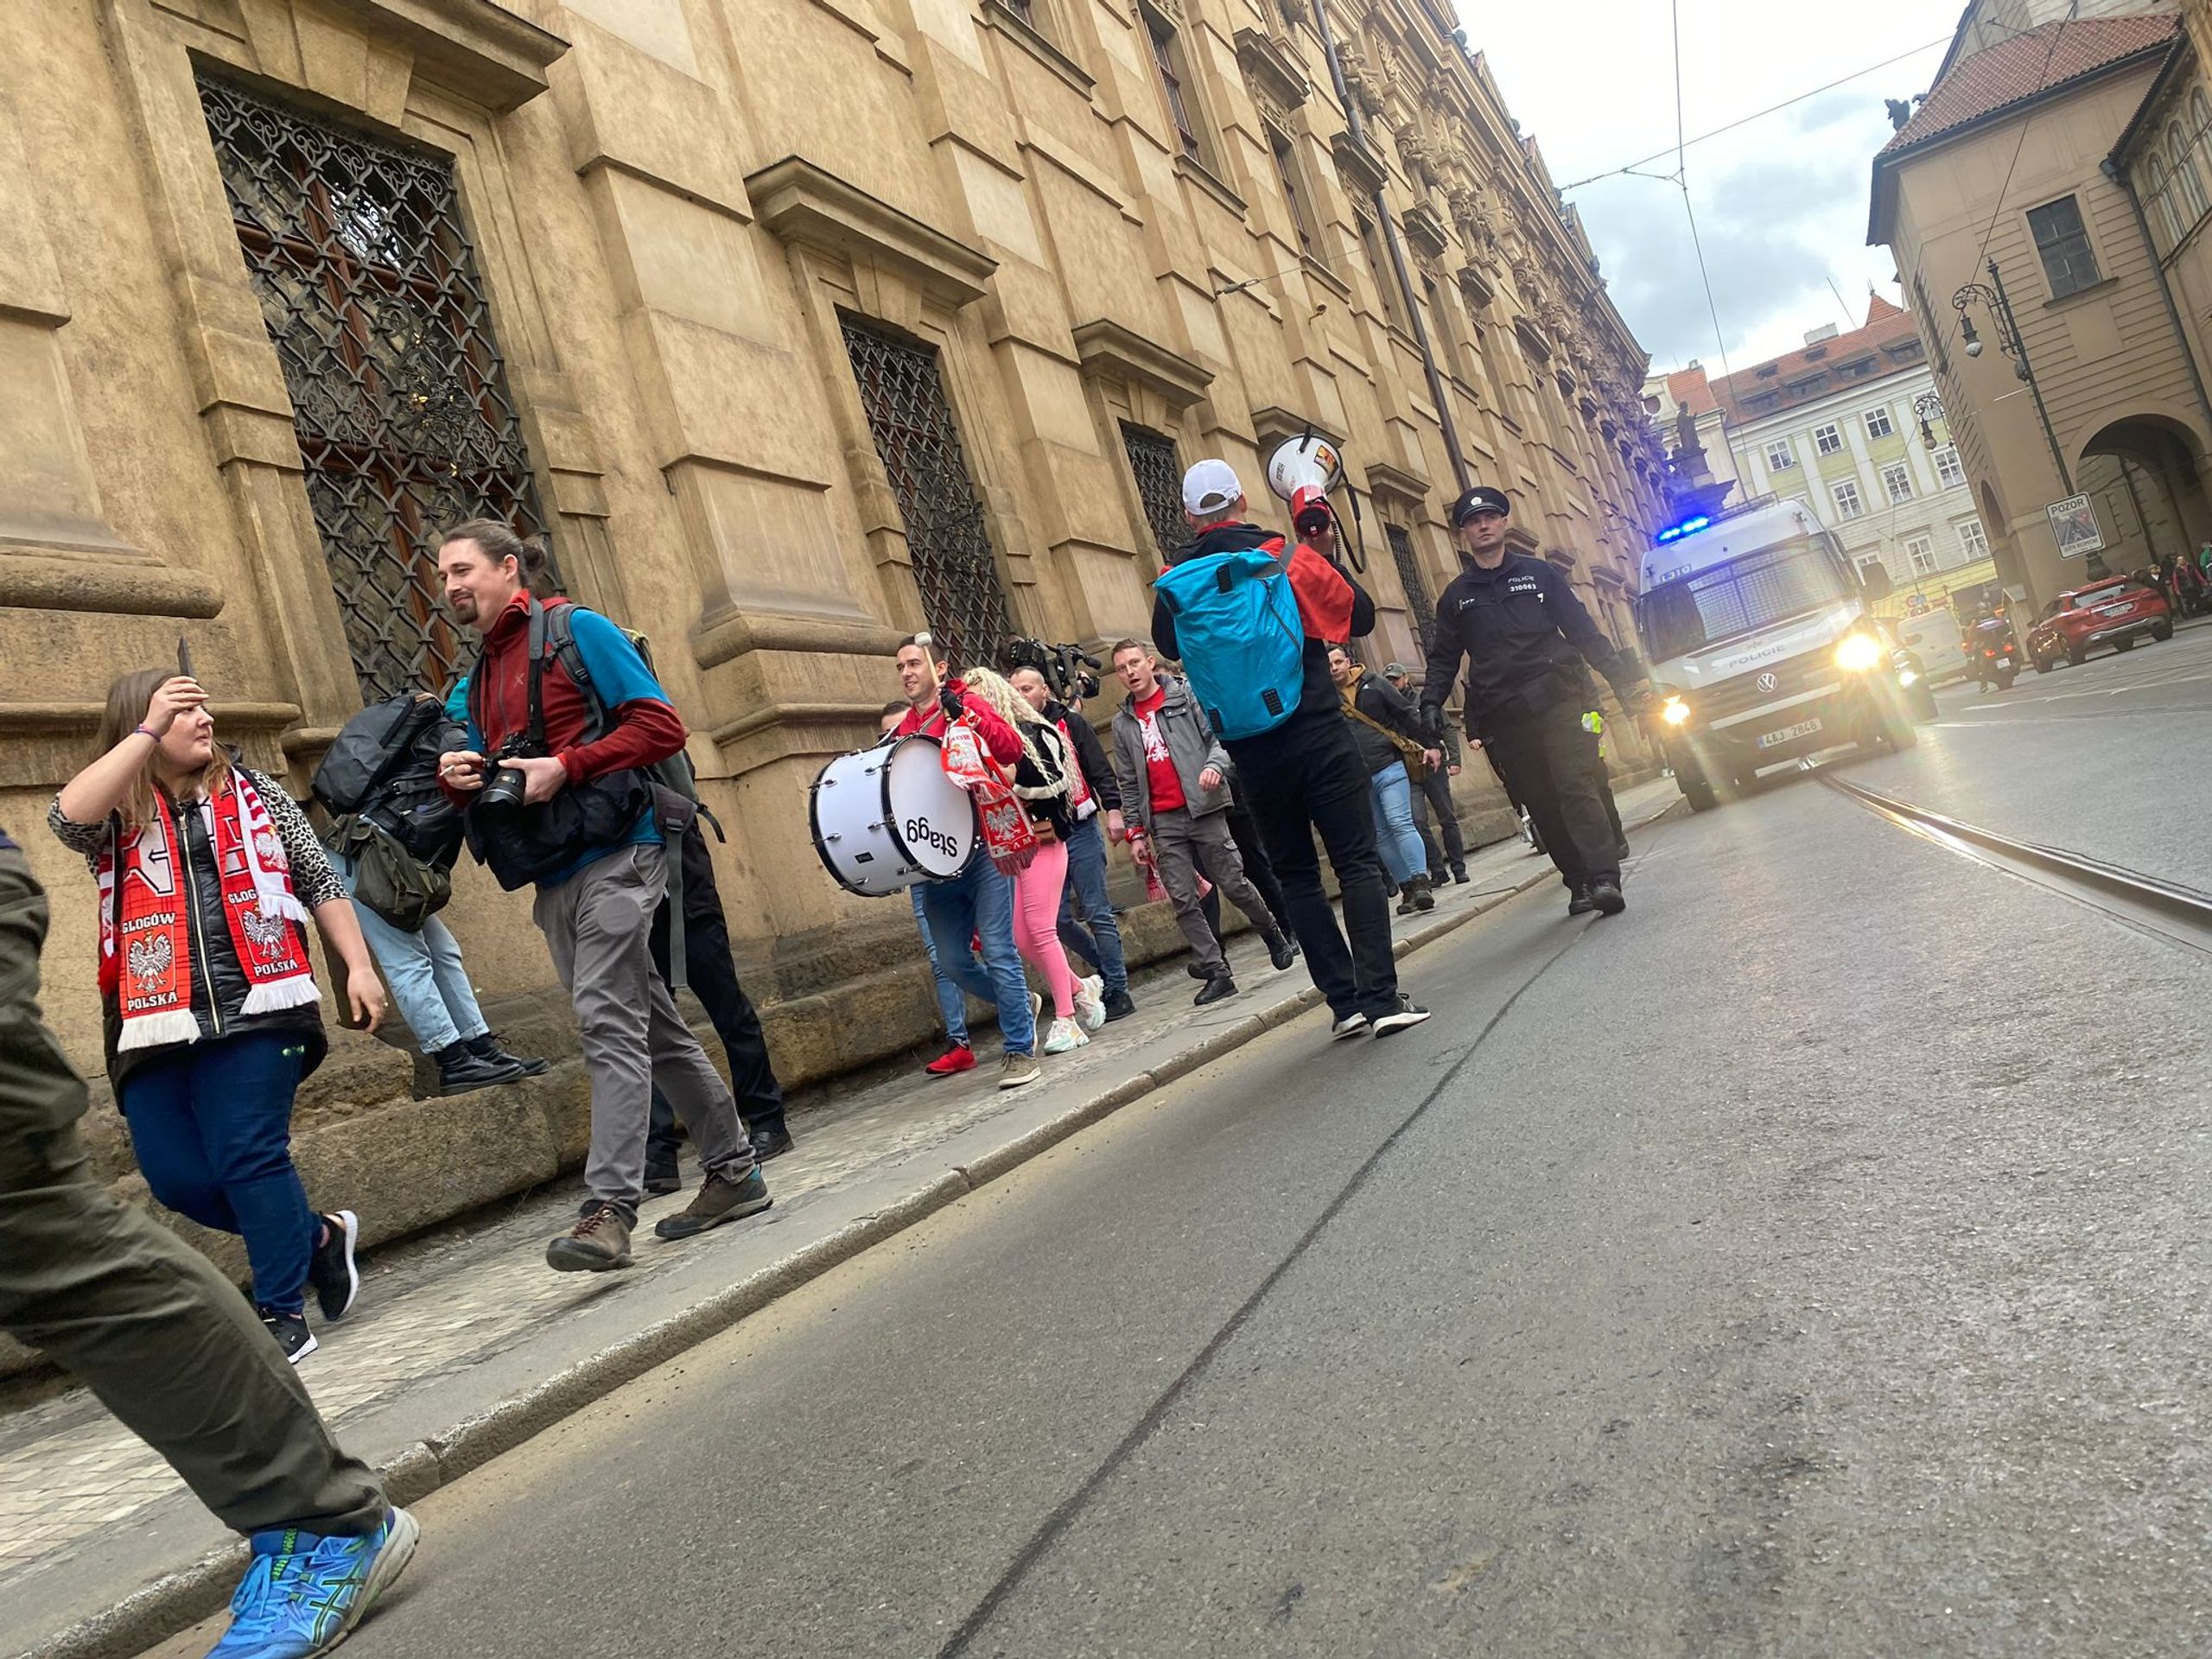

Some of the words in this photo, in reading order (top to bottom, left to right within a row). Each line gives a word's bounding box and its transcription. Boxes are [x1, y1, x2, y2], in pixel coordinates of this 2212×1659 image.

[2050, 498, 2085, 515] POZOR
[1729, 645, 1785, 668] POLICIE
[1766, 731, 1785, 745] 4AJ
[1790, 721, 1818, 737] 2846
[906, 817, 957, 857] Stagg
[253, 958, 298, 976] POLSKA
[127, 991, 178, 1011] POLSKA
